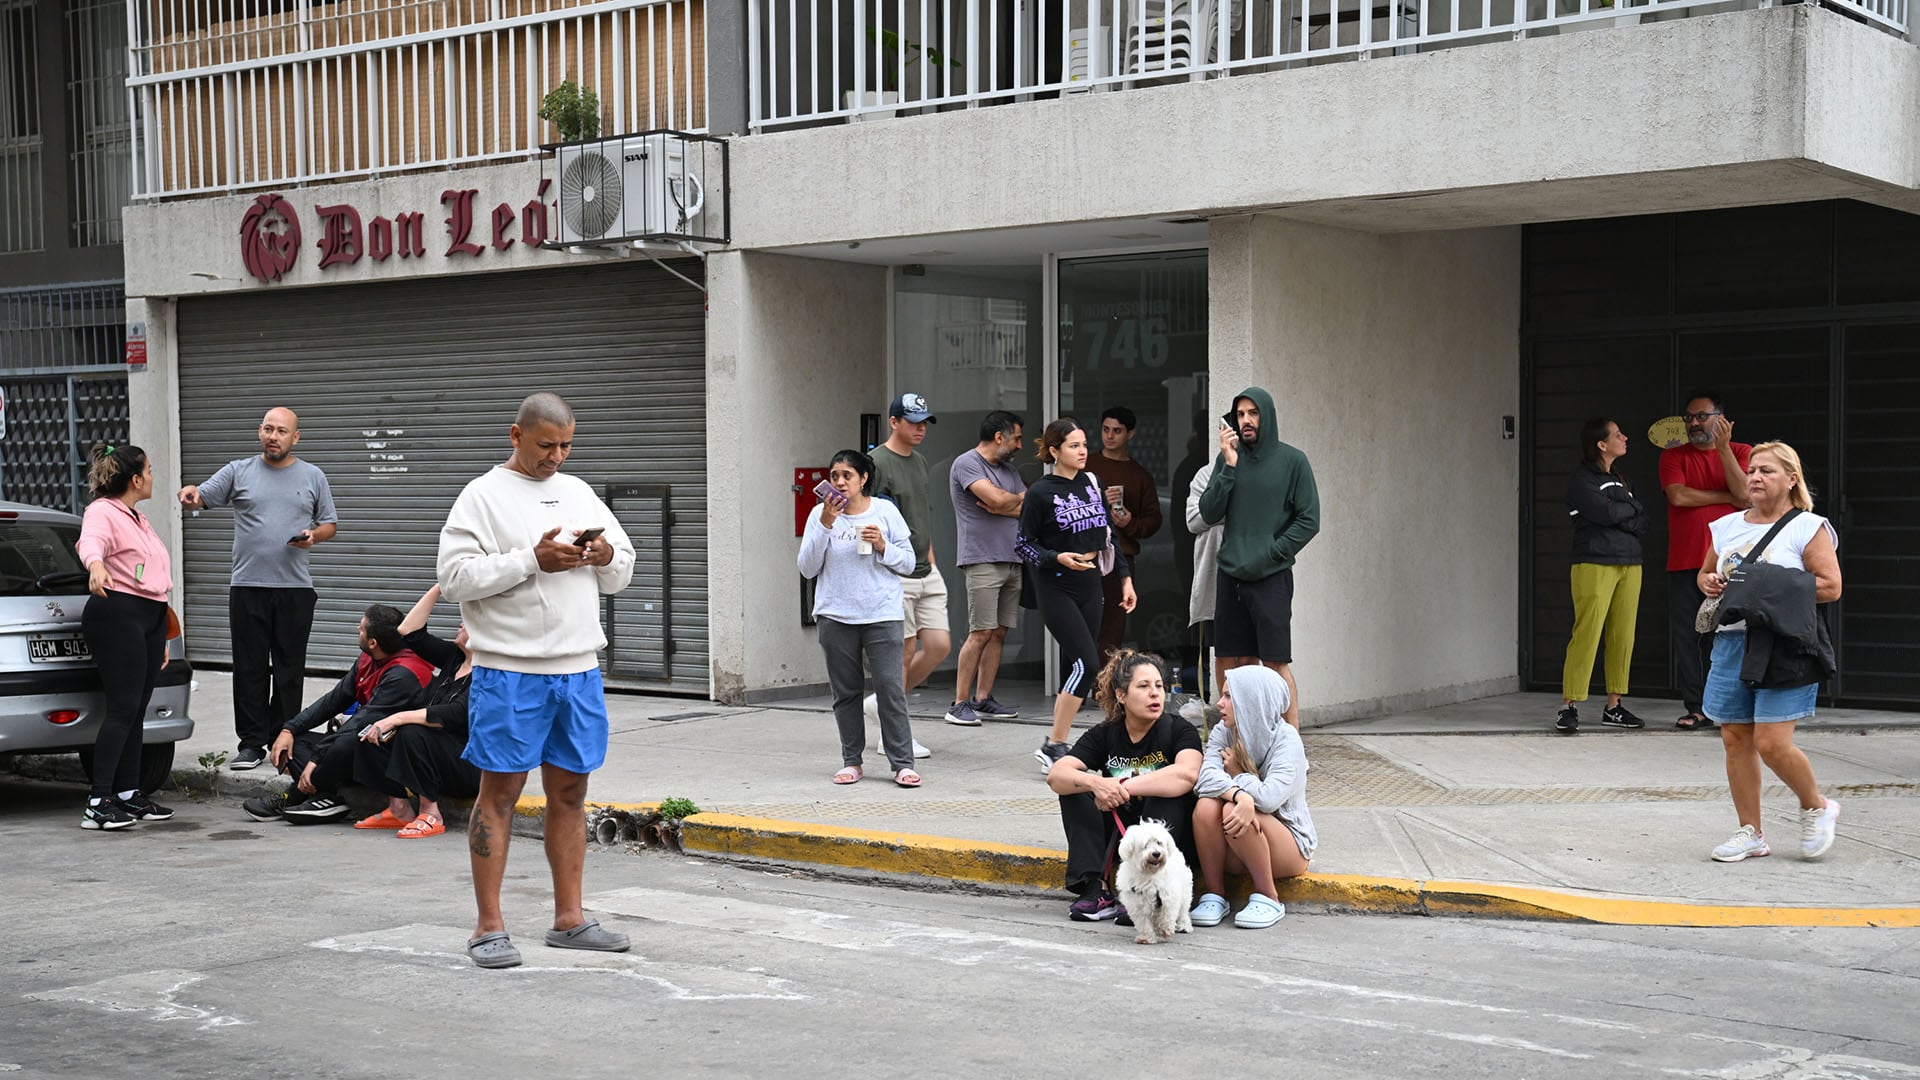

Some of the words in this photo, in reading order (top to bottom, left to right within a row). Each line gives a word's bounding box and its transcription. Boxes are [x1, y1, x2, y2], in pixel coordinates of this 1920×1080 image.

[315, 204, 427, 270] Don
[440, 179, 559, 257] Leó
[1081, 318, 1169, 369] 746
[1056, 504, 1106, 529] STRANGE
[1070, 515, 1107, 534] THINGS
[31, 641, 57, 657] HGM
[63, 640, 89, 656] 943
